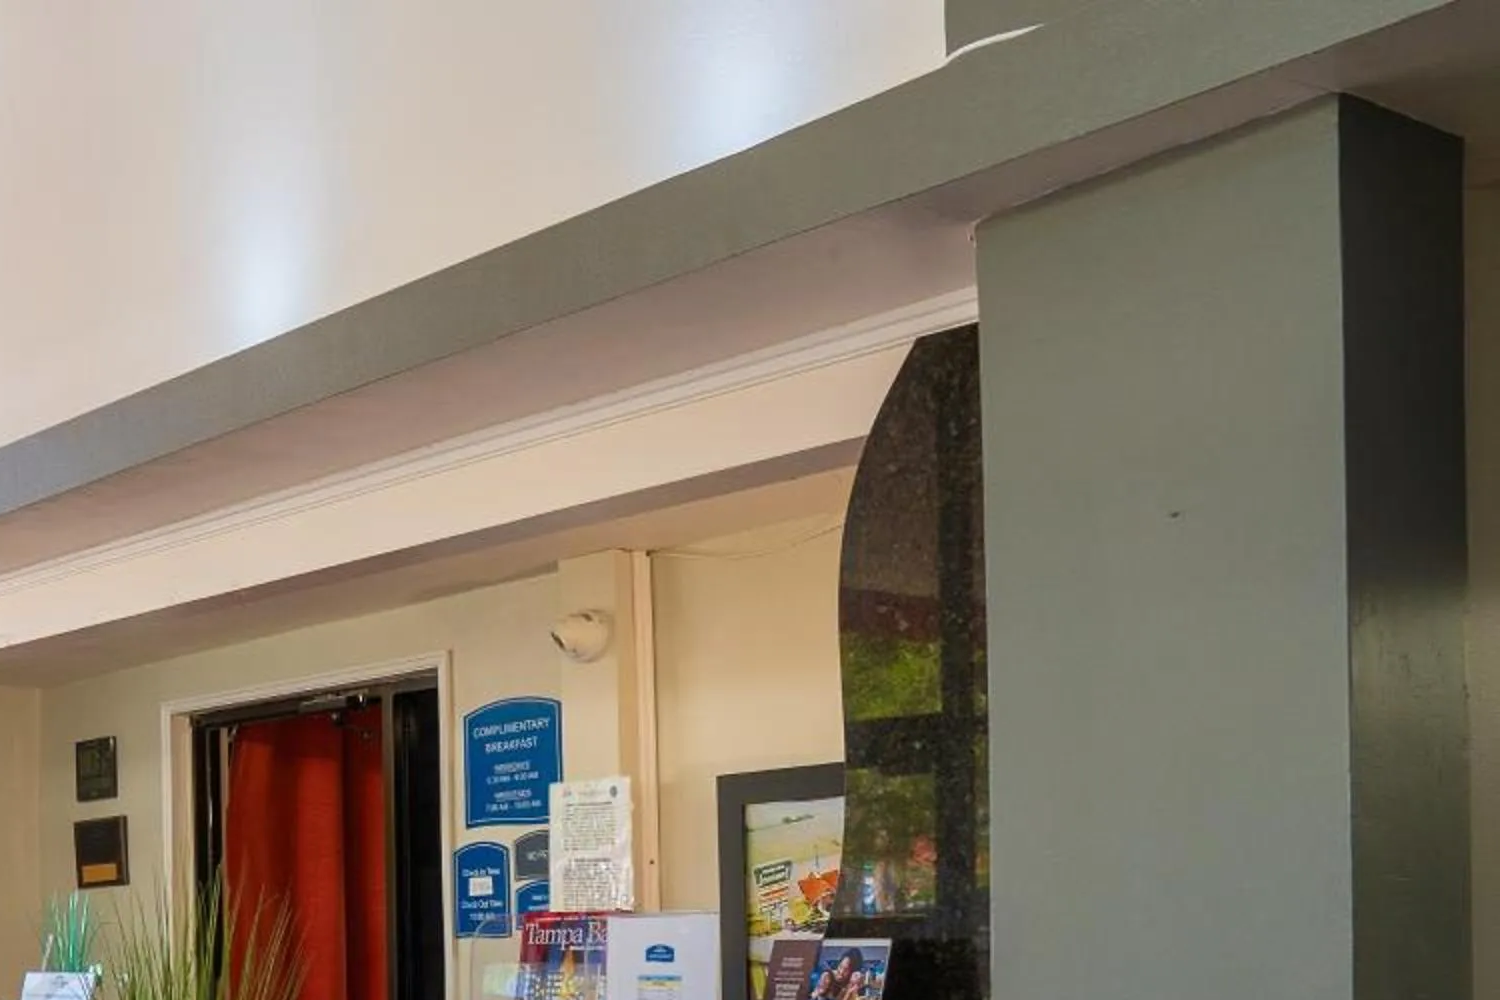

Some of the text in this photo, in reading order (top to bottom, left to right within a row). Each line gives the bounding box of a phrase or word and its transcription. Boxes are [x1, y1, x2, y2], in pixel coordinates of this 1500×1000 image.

[473, 716, 551, 740] COMPLIMENTARY
[485, 736, 538, 754] BREAKFAST
[526, 921, 609, 951] Tampa Ba
